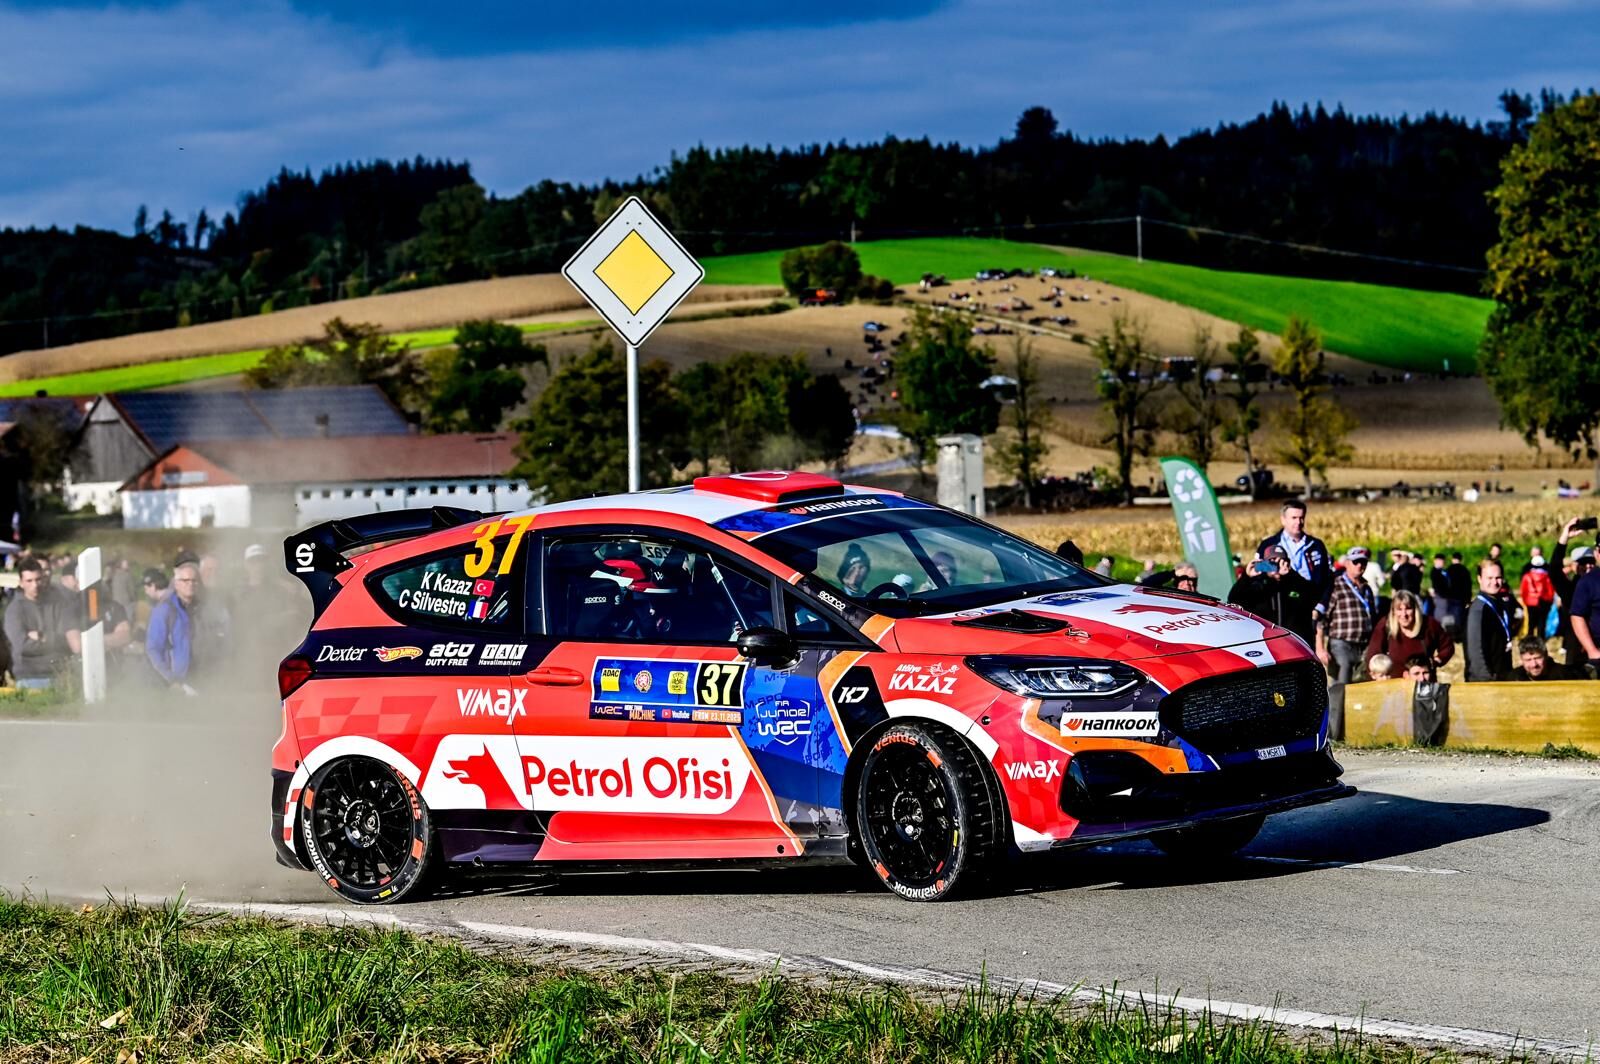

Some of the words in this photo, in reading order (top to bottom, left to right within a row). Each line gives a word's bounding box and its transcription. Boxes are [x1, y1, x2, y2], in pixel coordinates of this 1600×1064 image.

[463, 514, 537, 578] 37
[420, 571, 434, 589] K
[433, 573, 473, 596] Kazaz
[399, 589, 411, 608] C
[410, 591, 467, 617] Silvestre
[315, 645, 368, 662] Dexter
[602, 669, 620, 678] ADAC
[888, 673, 958, 695] KAZAZ
[701, 664, 740, 706] 37
[594, 705, 623, 715] WRC
[760, 708, 807, 718] JUNIOR
[757, 720, 812, 736] WRC
[520, 755, 632, 798] Petrol
[643, 756, 731, 799] Ofisi
